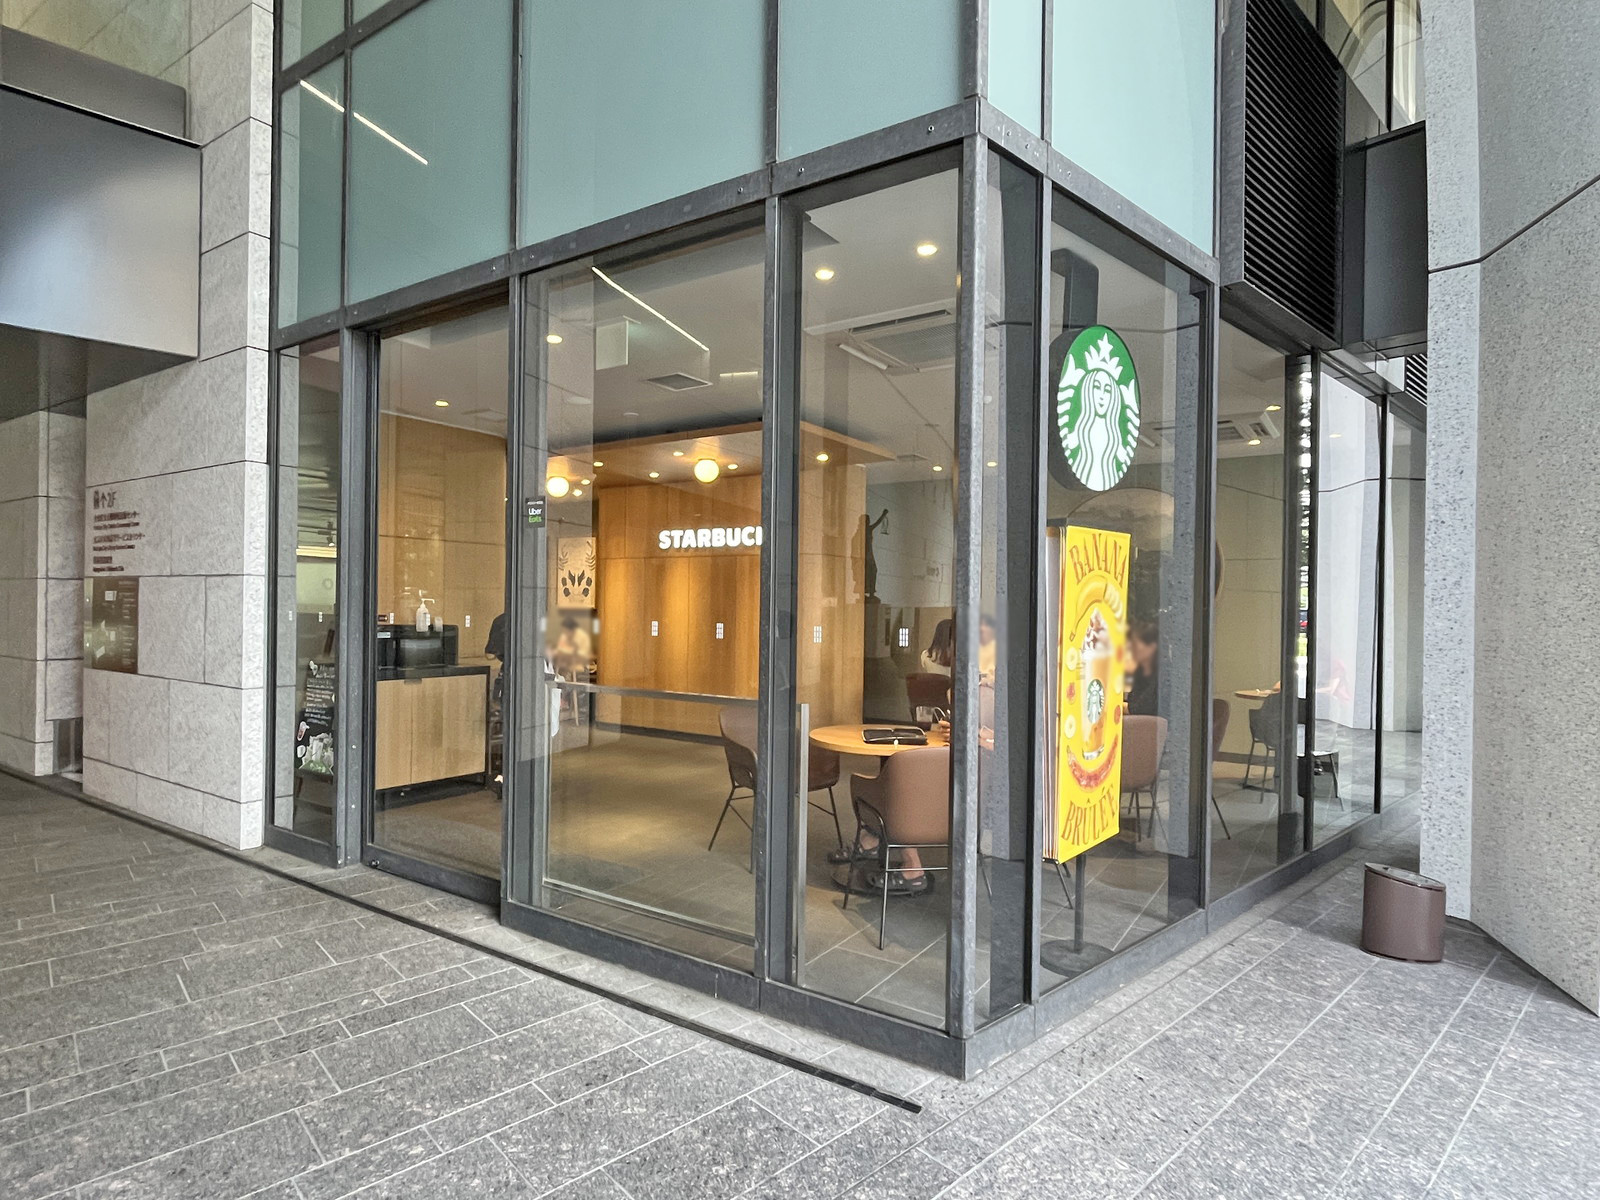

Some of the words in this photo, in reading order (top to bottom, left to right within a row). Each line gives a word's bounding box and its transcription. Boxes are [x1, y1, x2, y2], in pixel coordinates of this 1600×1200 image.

[528, 507, 542, 515] Uber
[528, 515, 542, 523] Eats
[1069, 533, 1128, 588] BANANA
